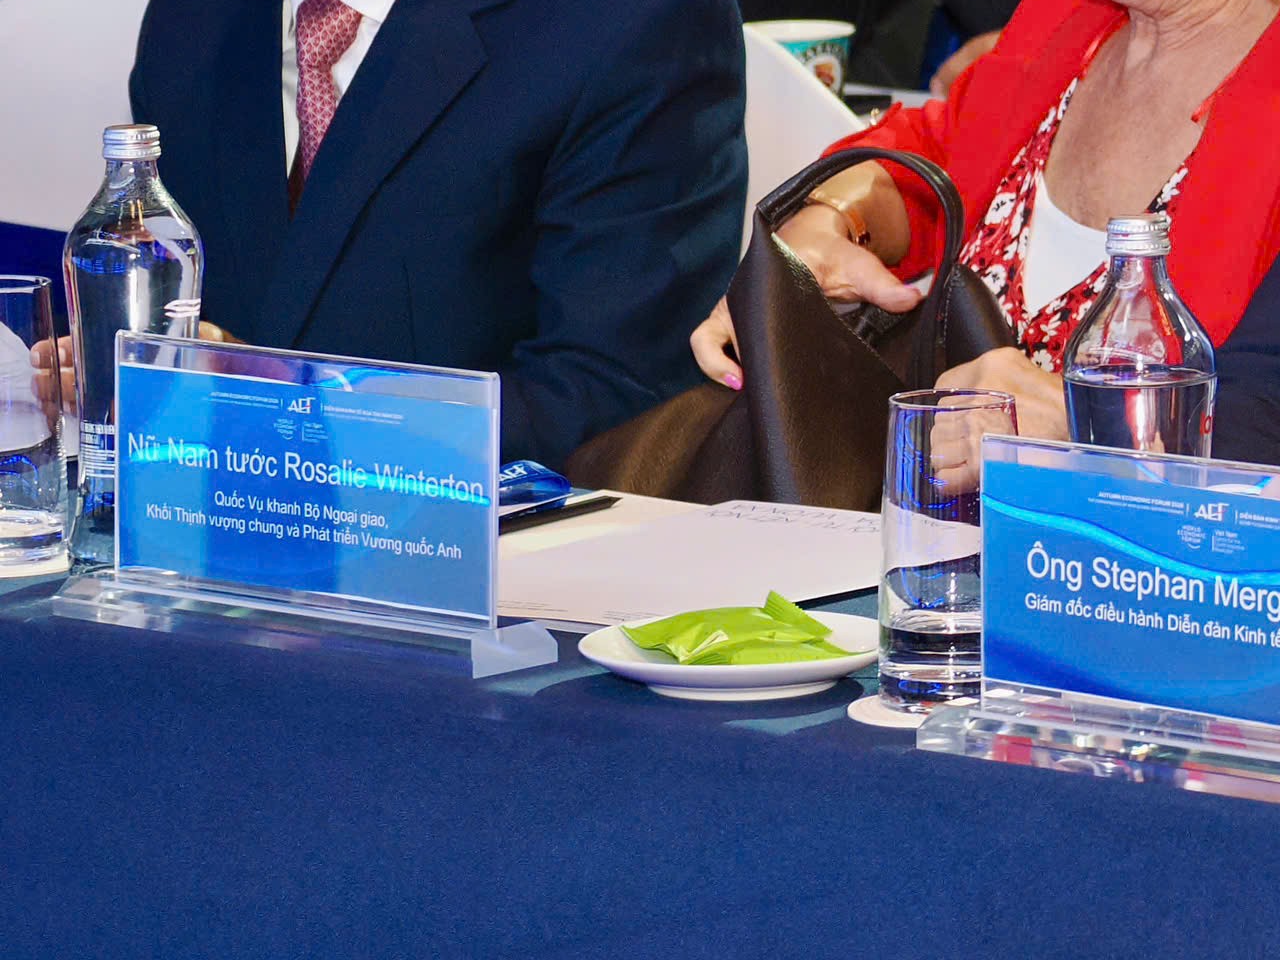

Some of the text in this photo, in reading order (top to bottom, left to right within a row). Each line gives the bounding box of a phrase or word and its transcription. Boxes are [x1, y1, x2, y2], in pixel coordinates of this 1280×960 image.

[128, 432, 160, 461] Nữ
[168, 437, 218, 470] Nam
[225, 445, 278, 477] tước
[285, 451, 367, 488] Rosalie
[375, 463, 484, 503] Winterton
[147, 503, 462, 559] Khối Thịnh vượng chung và Phát triển Vương quốc Anh
[215, 490, 389, 529] Quốc Vụ khanh Bộ Ngoại giao,
[1027, 541, 1082, 591] Ông
[1092, 557, 1204, 603] Stephan
[1025, 592, 1062, 613] Giám
[1066, 597, 1092, 618] đốc
[1095, 601, 1125, 623] điều
[1129, 608, 1163, 630] hành
[1168, 613, 1200, 636] Diễn
[1203, 621, 1230, 640] đàn
[1235, 624, 1266, 646] Kinh
